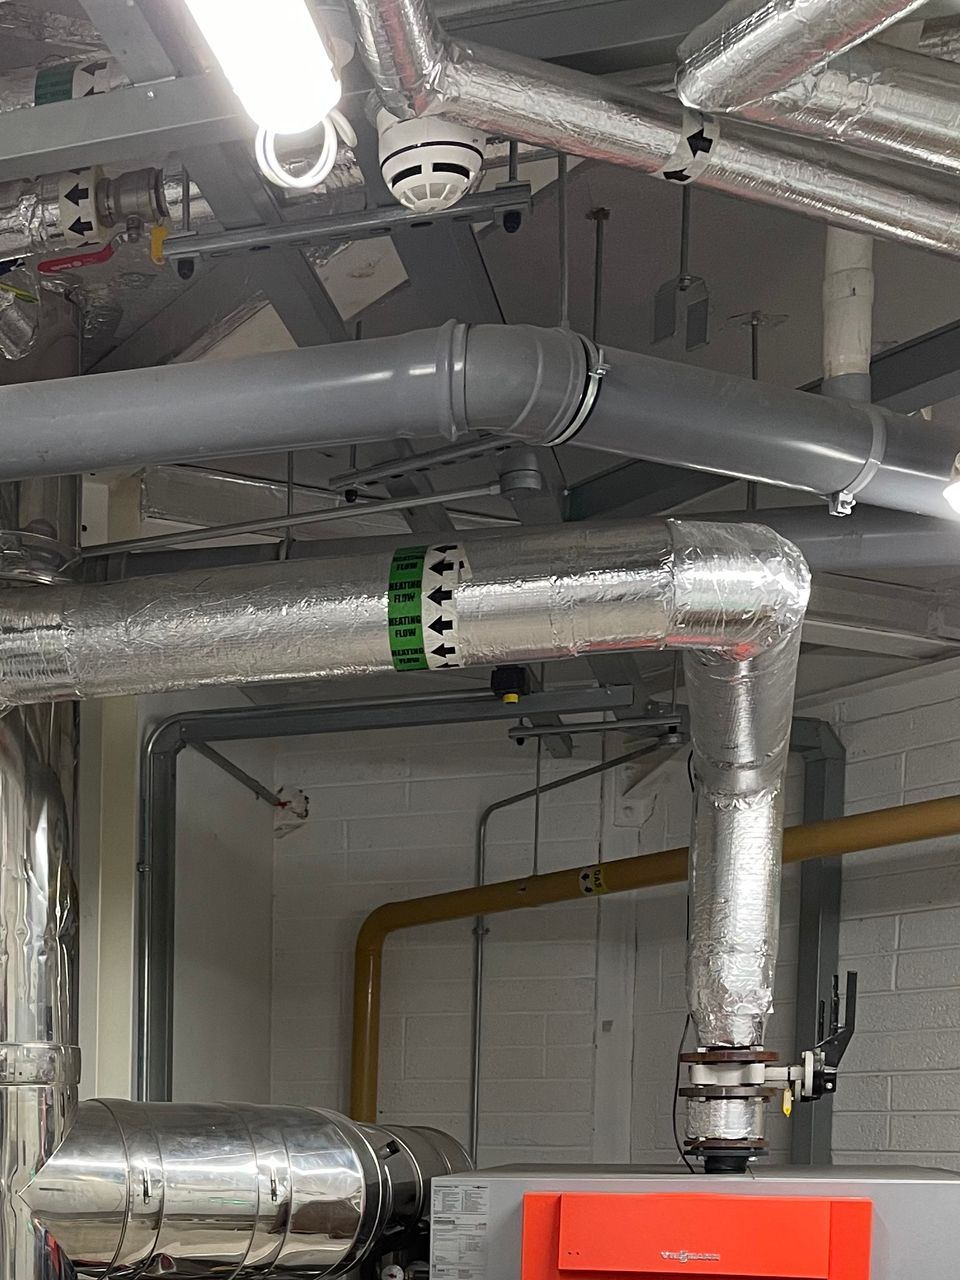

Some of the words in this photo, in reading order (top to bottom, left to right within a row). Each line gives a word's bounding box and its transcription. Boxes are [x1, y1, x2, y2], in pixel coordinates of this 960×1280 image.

[396, 562, 418, 570] FLOW
[389, 580, 421, 591] HEATING
[394, 592, 416, 603] FLOW
[389, 615, 422, 626] HEATING
[395, 628, 417, 638] FLOW
[392, 647, 425, 657] HEATING
